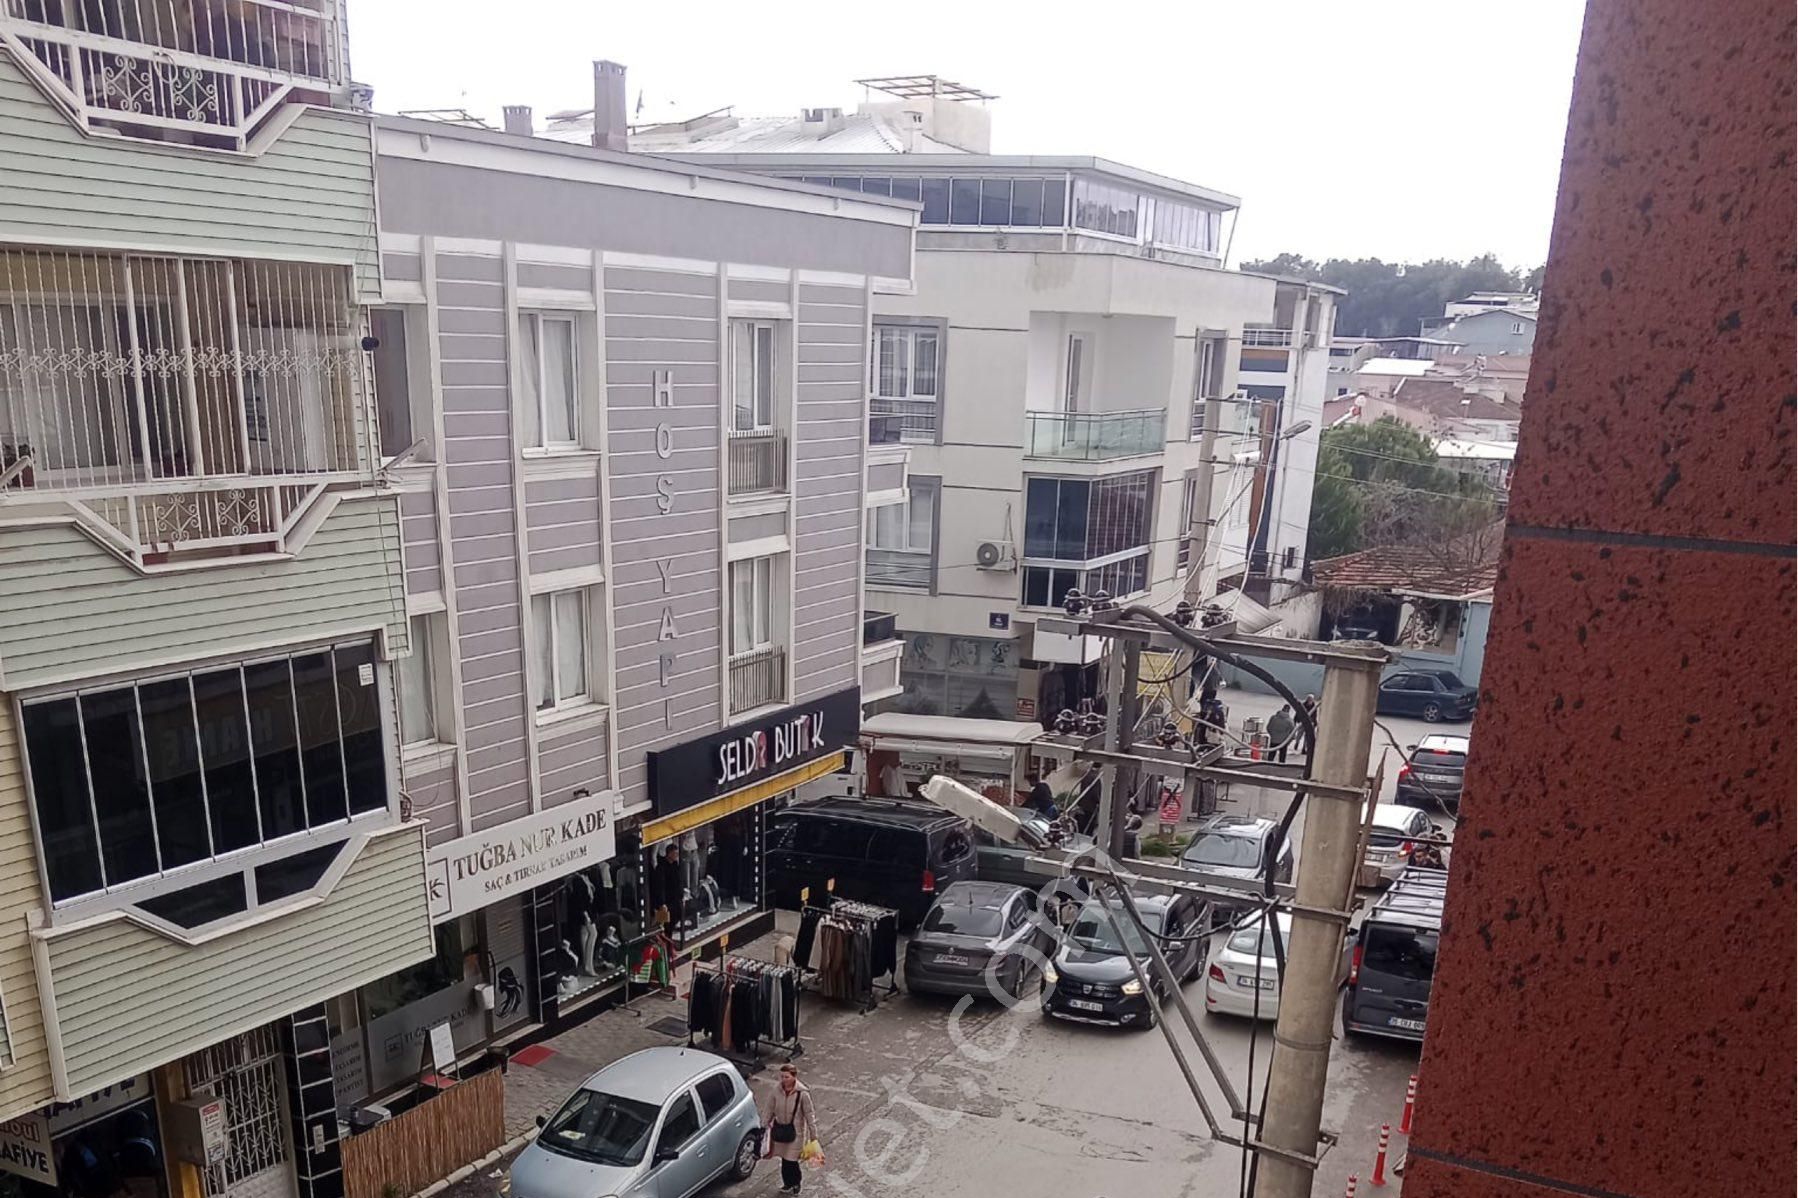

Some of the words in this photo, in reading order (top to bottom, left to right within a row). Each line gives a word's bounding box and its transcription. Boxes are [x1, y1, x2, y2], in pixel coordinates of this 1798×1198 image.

[652, 369, 674, 516] HOŞ
[656, 558, 679, 731] YAPI
[453, 840, 517, 881] TUĞBA
[521, 826, 558, 858] NUR
[561, 808, 607, 843] KADE
